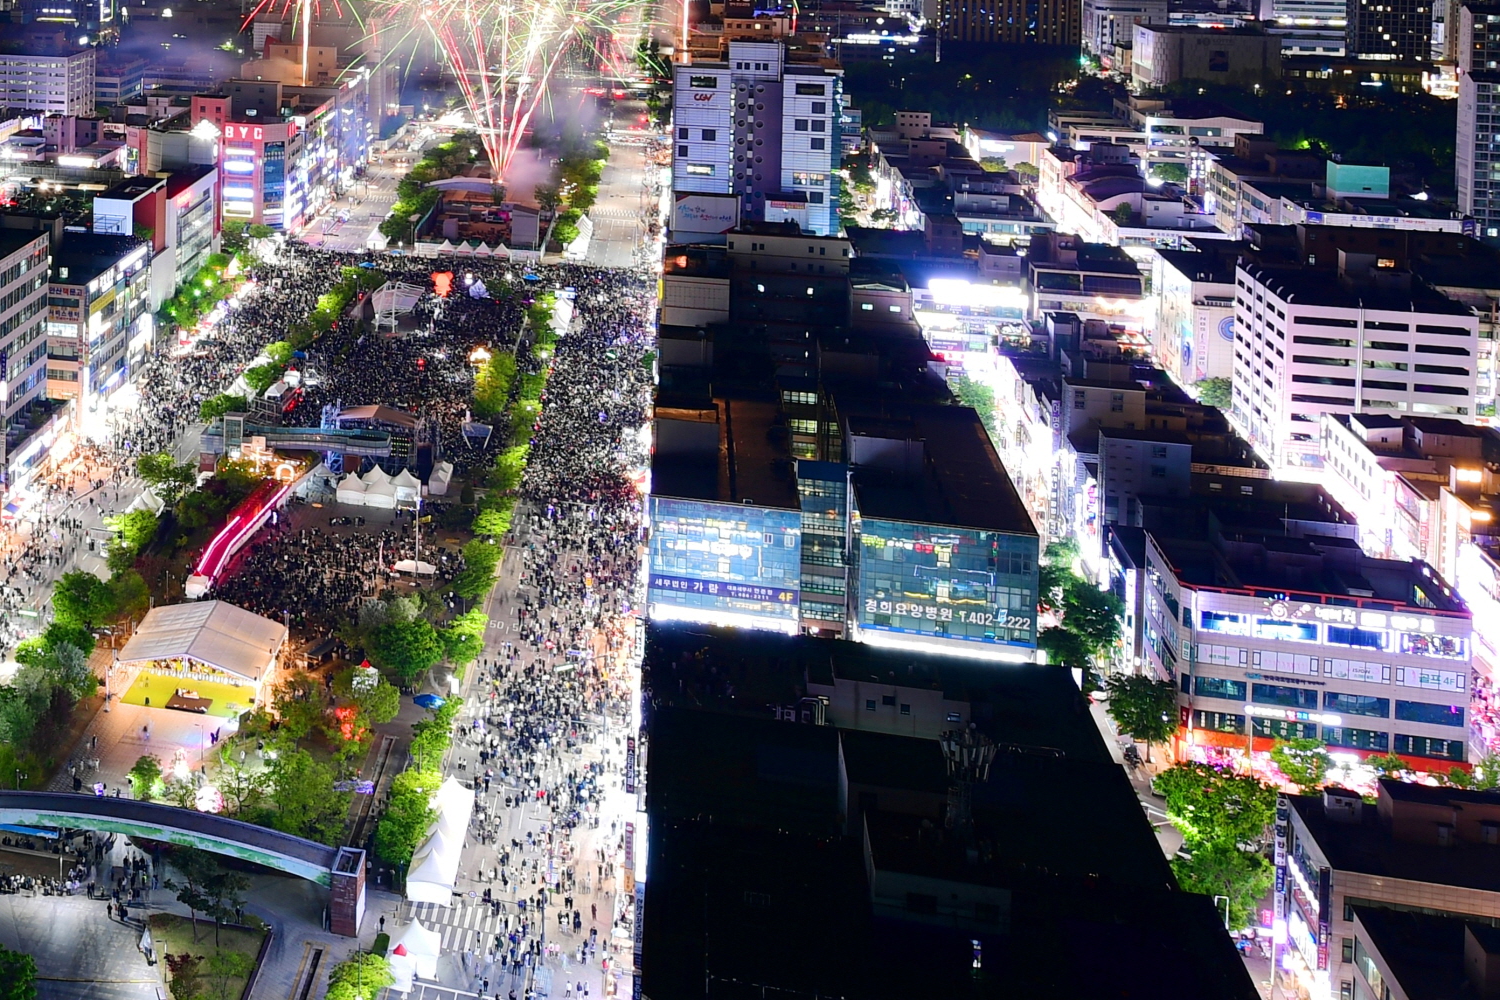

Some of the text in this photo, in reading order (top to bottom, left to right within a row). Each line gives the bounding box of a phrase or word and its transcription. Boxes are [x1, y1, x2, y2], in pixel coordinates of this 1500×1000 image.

[694, 93, 713, 101] CGV
[225, 126, 263, 140] BYC
[655, 578, 719, 594] 세무법인 가람
[778, 592, 793, 602] 4F
[865, 599, 953, 622] 경희요양병원
[1443, 676, 1455, 685] 4F
